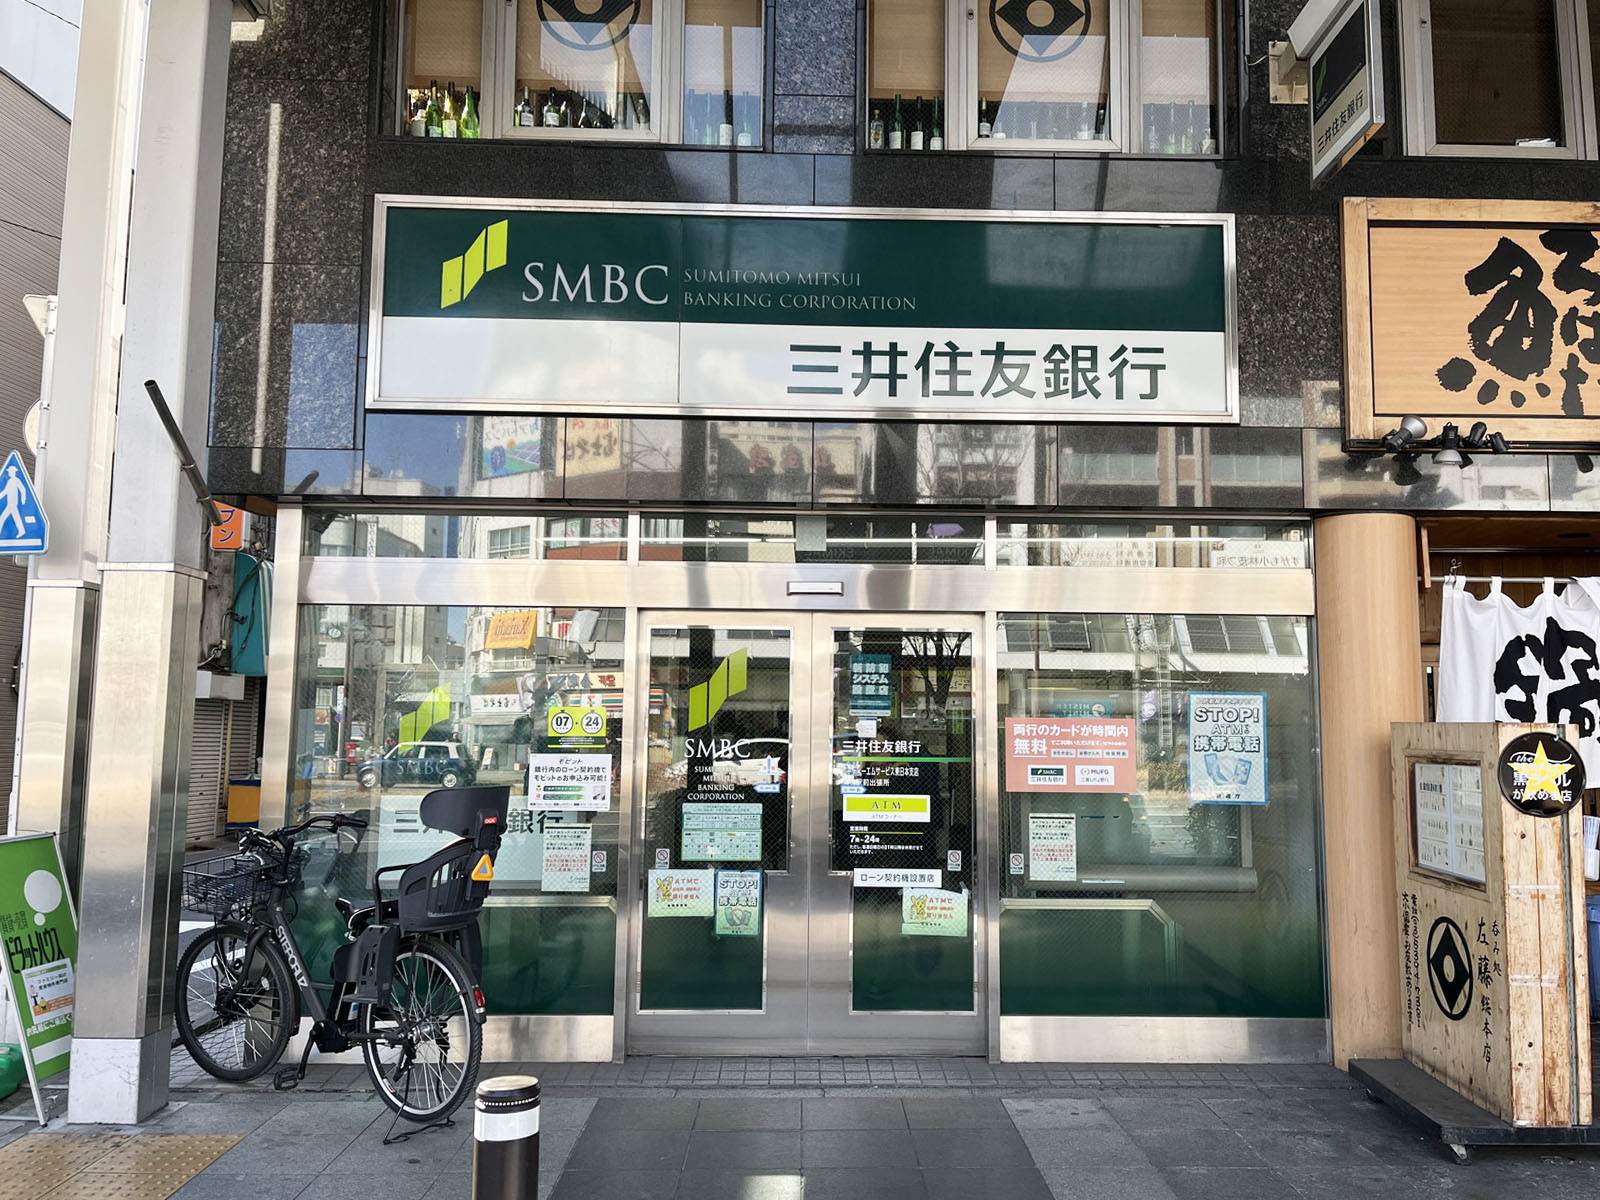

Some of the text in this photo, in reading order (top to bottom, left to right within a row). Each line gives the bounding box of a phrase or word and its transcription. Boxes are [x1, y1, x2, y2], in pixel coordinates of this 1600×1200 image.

[1317, 90, 1364, 153] 三井住友銀行
[521, 261, 669, 305] SMBC
[684, 269, 862, 287] SUMITOMO MITSUI
[684, 291, 917, 311] BANKING CORPORATION
[787, 342, 1166, 401] 三井住友銀行
[852, 674, 889, 684] システム
[555, 716, 599, 727] 07 24
[1194, 707, 1259, 723] STOP!
[1013, 723, 1129, 738] 両行のカードが時間内
[684, 738, 751, 758] SMBC
[842, 740, 921, 754] 三井住友銀行
[1014, 738, 1048, 755] 無料
[1193, 735, 1260, 753] 携帯電話
[1516, 753, 1534, 762] the
[871, 800, 902, 810] ATM
[719, 878, 758, 890] STOP!
[860, 873, 935, 883] ローン契約機設置店
[5, 927, 66, 974] ピタットハウス
